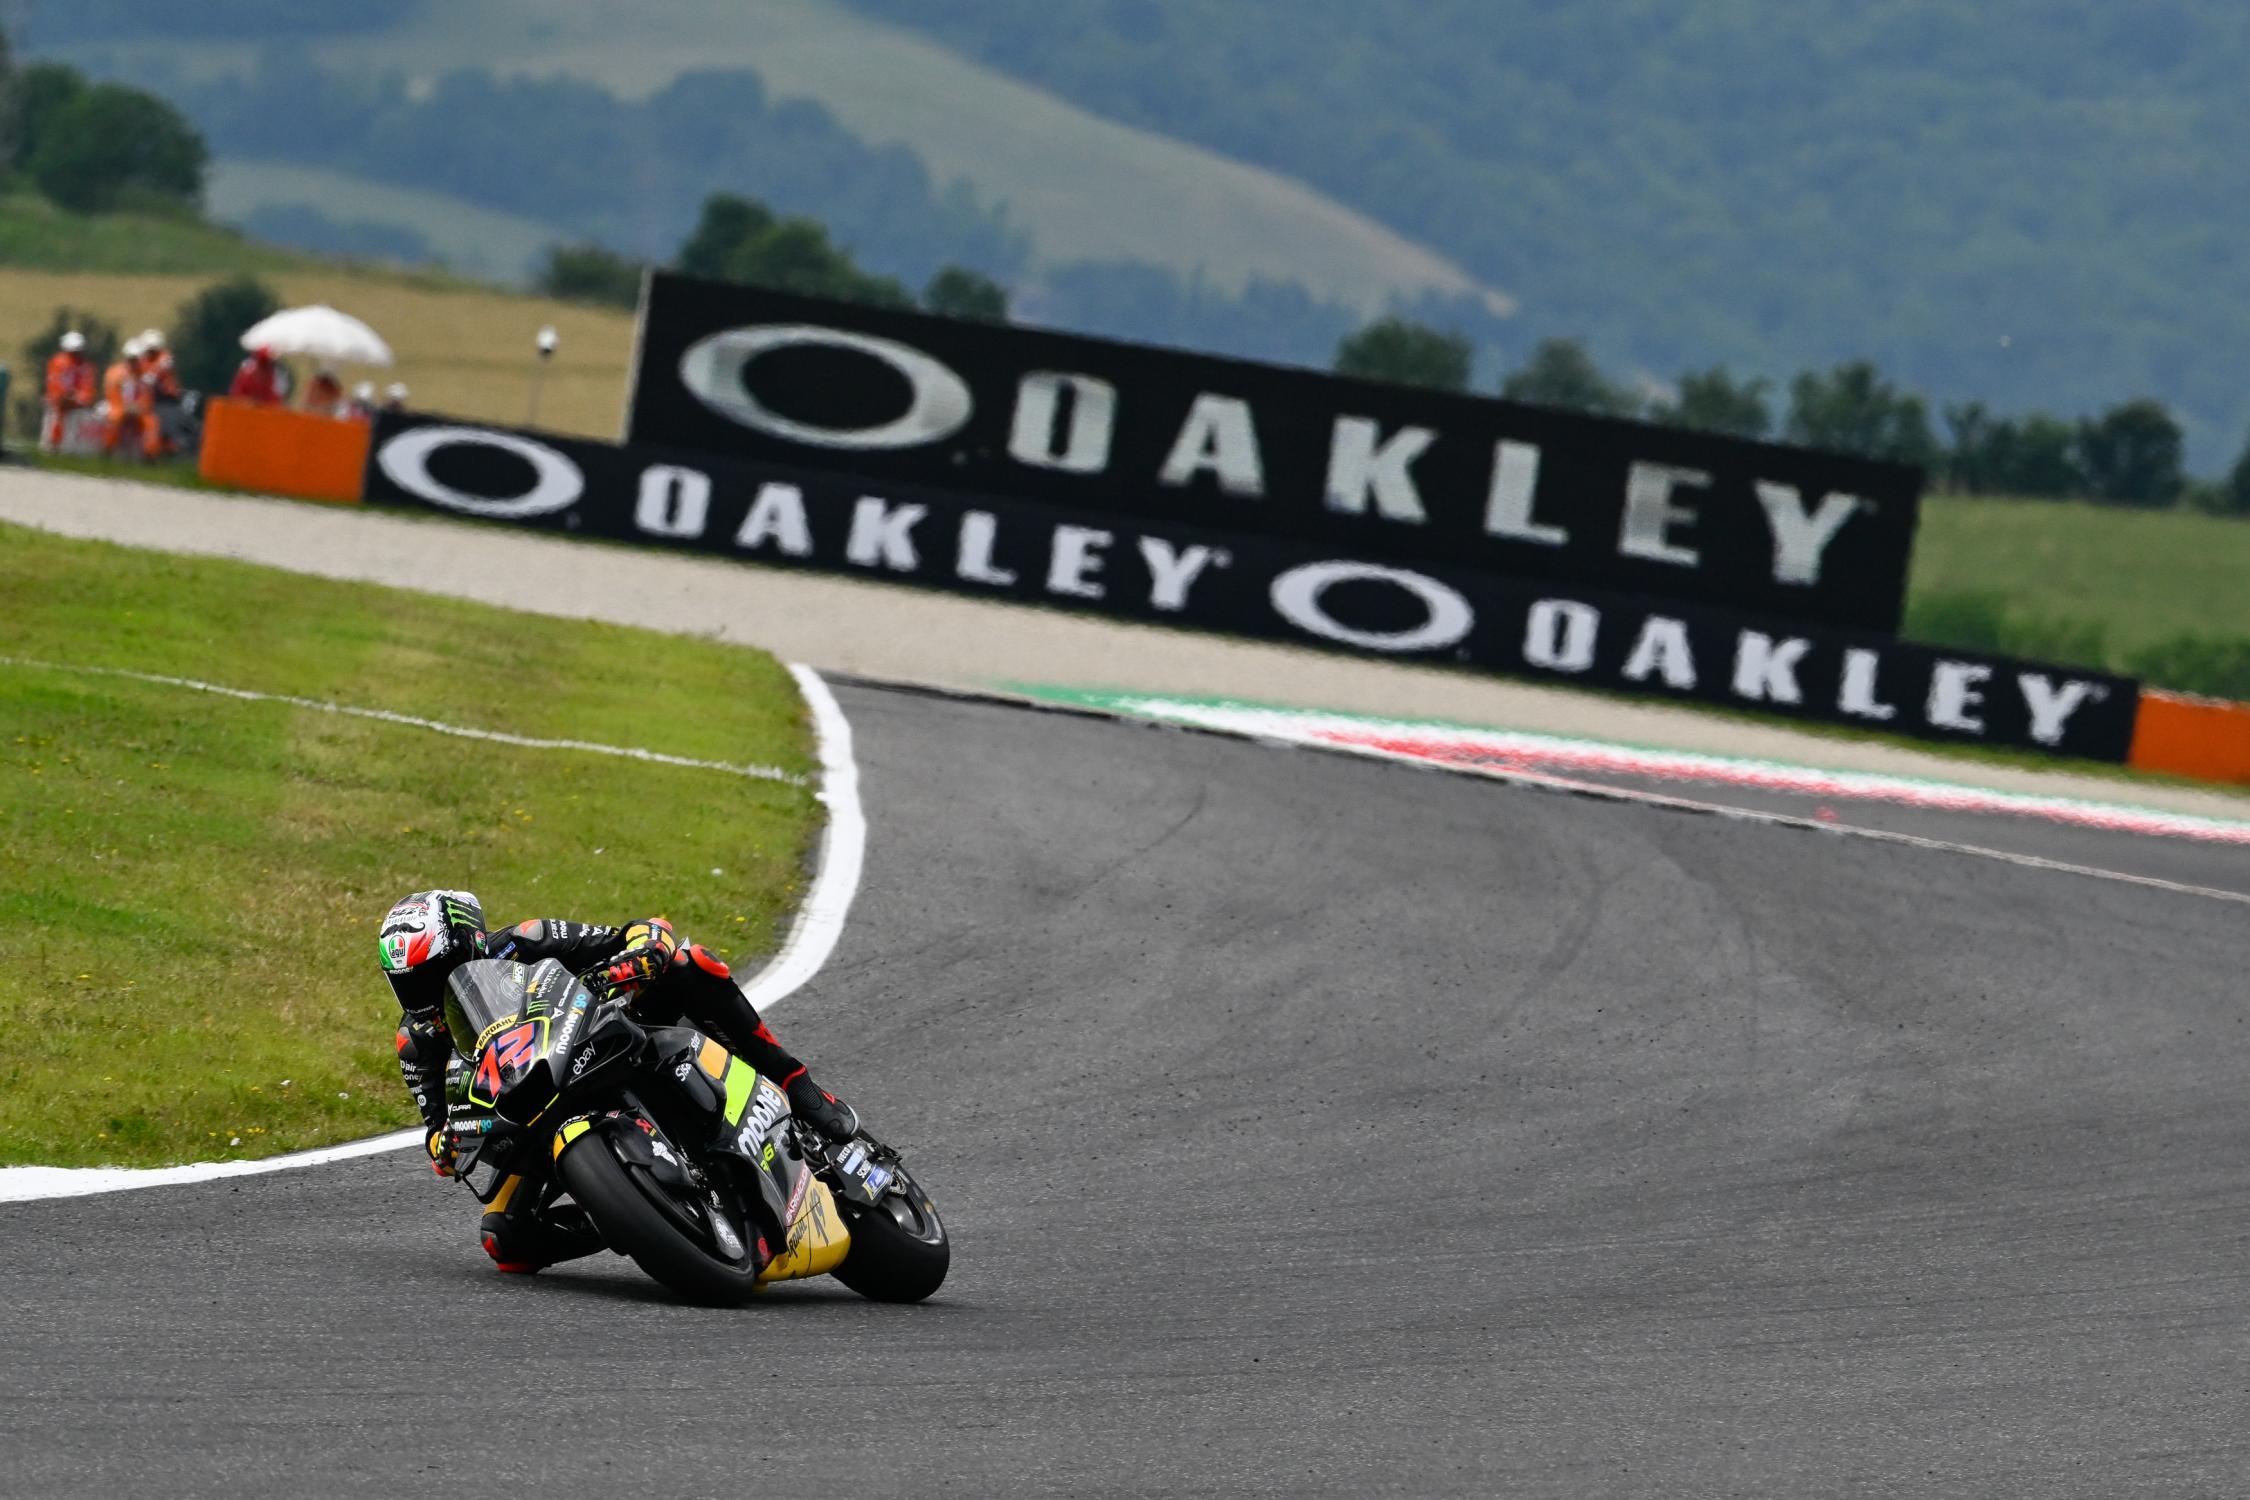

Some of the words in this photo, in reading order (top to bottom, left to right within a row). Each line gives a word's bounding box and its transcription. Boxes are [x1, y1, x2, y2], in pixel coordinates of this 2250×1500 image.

[635, 464, 1213, 609] OAKLEY
[1008, 373, 1857, 584] OAKLEY
[1522, 599, 2091, 743] OAKLEY
[478, 1018, 515, 1046] BARDAHL
[572, 1041, 597, 1075] ebay
